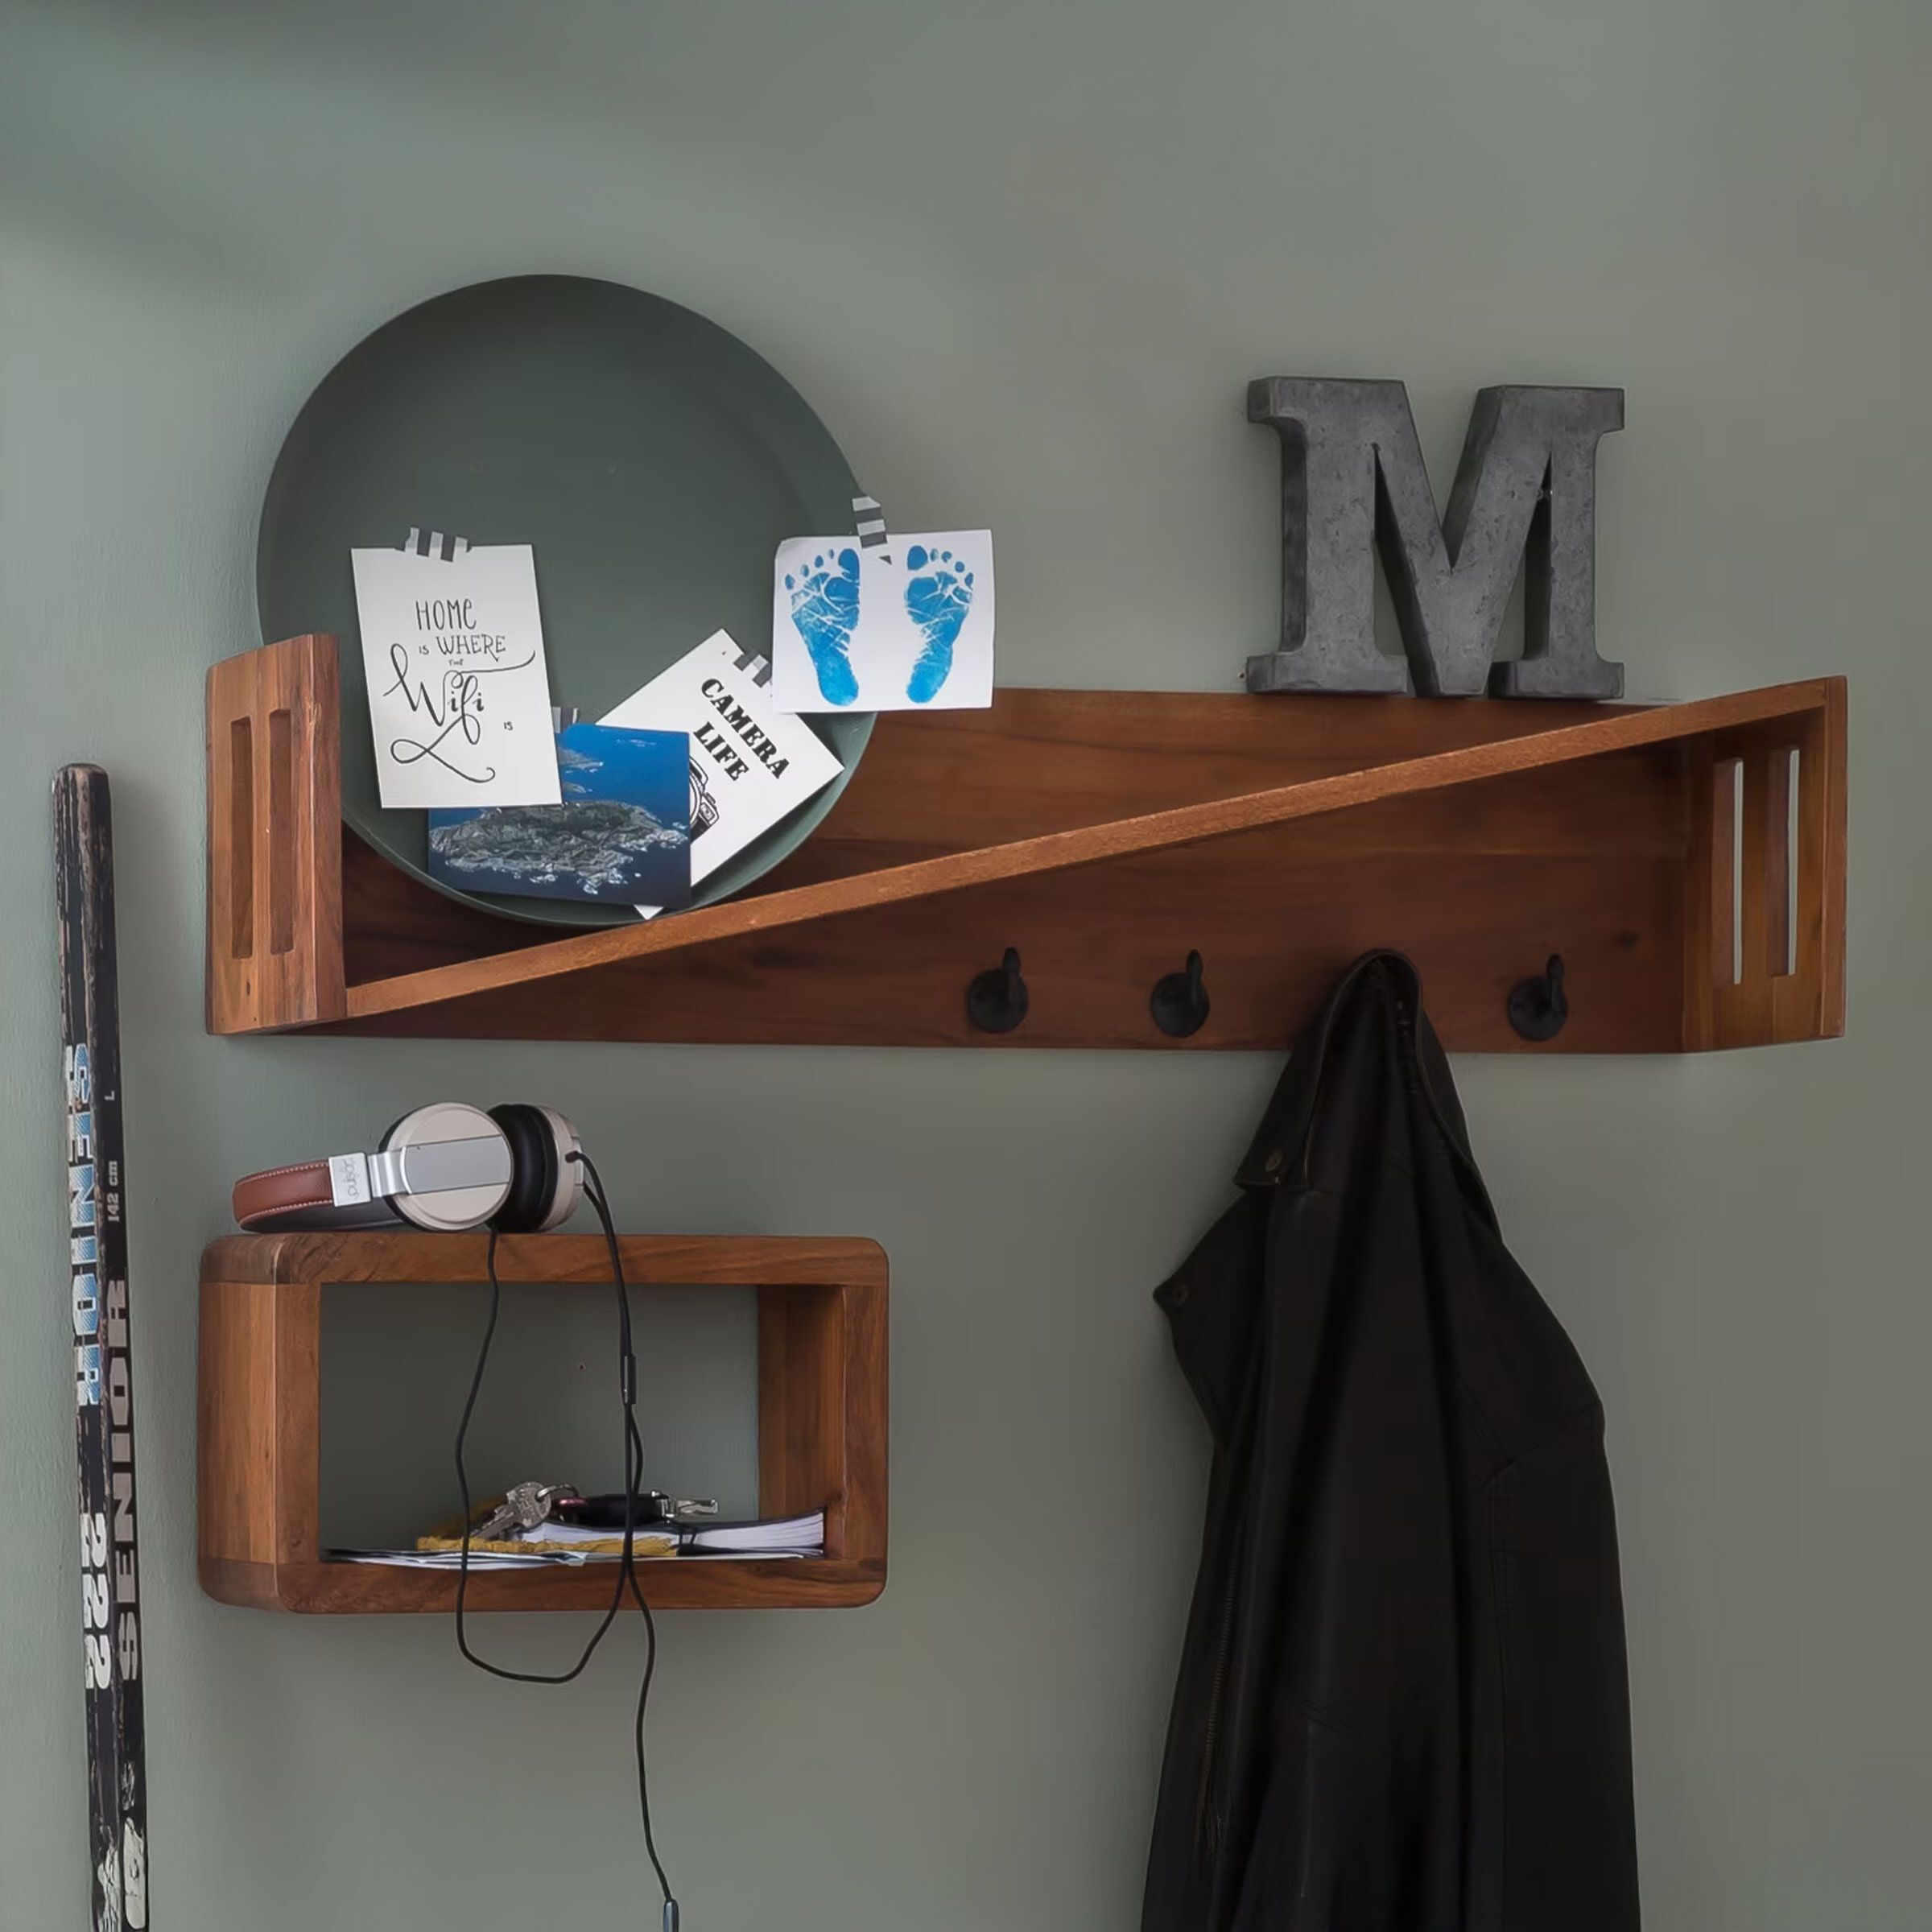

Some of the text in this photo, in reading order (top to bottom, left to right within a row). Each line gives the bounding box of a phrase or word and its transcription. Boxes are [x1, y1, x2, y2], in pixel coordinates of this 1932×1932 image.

[1246, 376, 1624, 699] M
[419, 634, 506, 663] IS WHERE
[503, 721, 514, 731] IS
[693, 721, 749, 780] LIFE
[701, 679, 790, 779] CAMERA
[105, 1091, 115, 1101] L
[67, 1044, 99, 1406] SENIOR
[107, 1161, 120, 1222] 142 cm
[106, 1280, 138, 1681] SENIOR
[81, 1513, 111, 1689] 222
